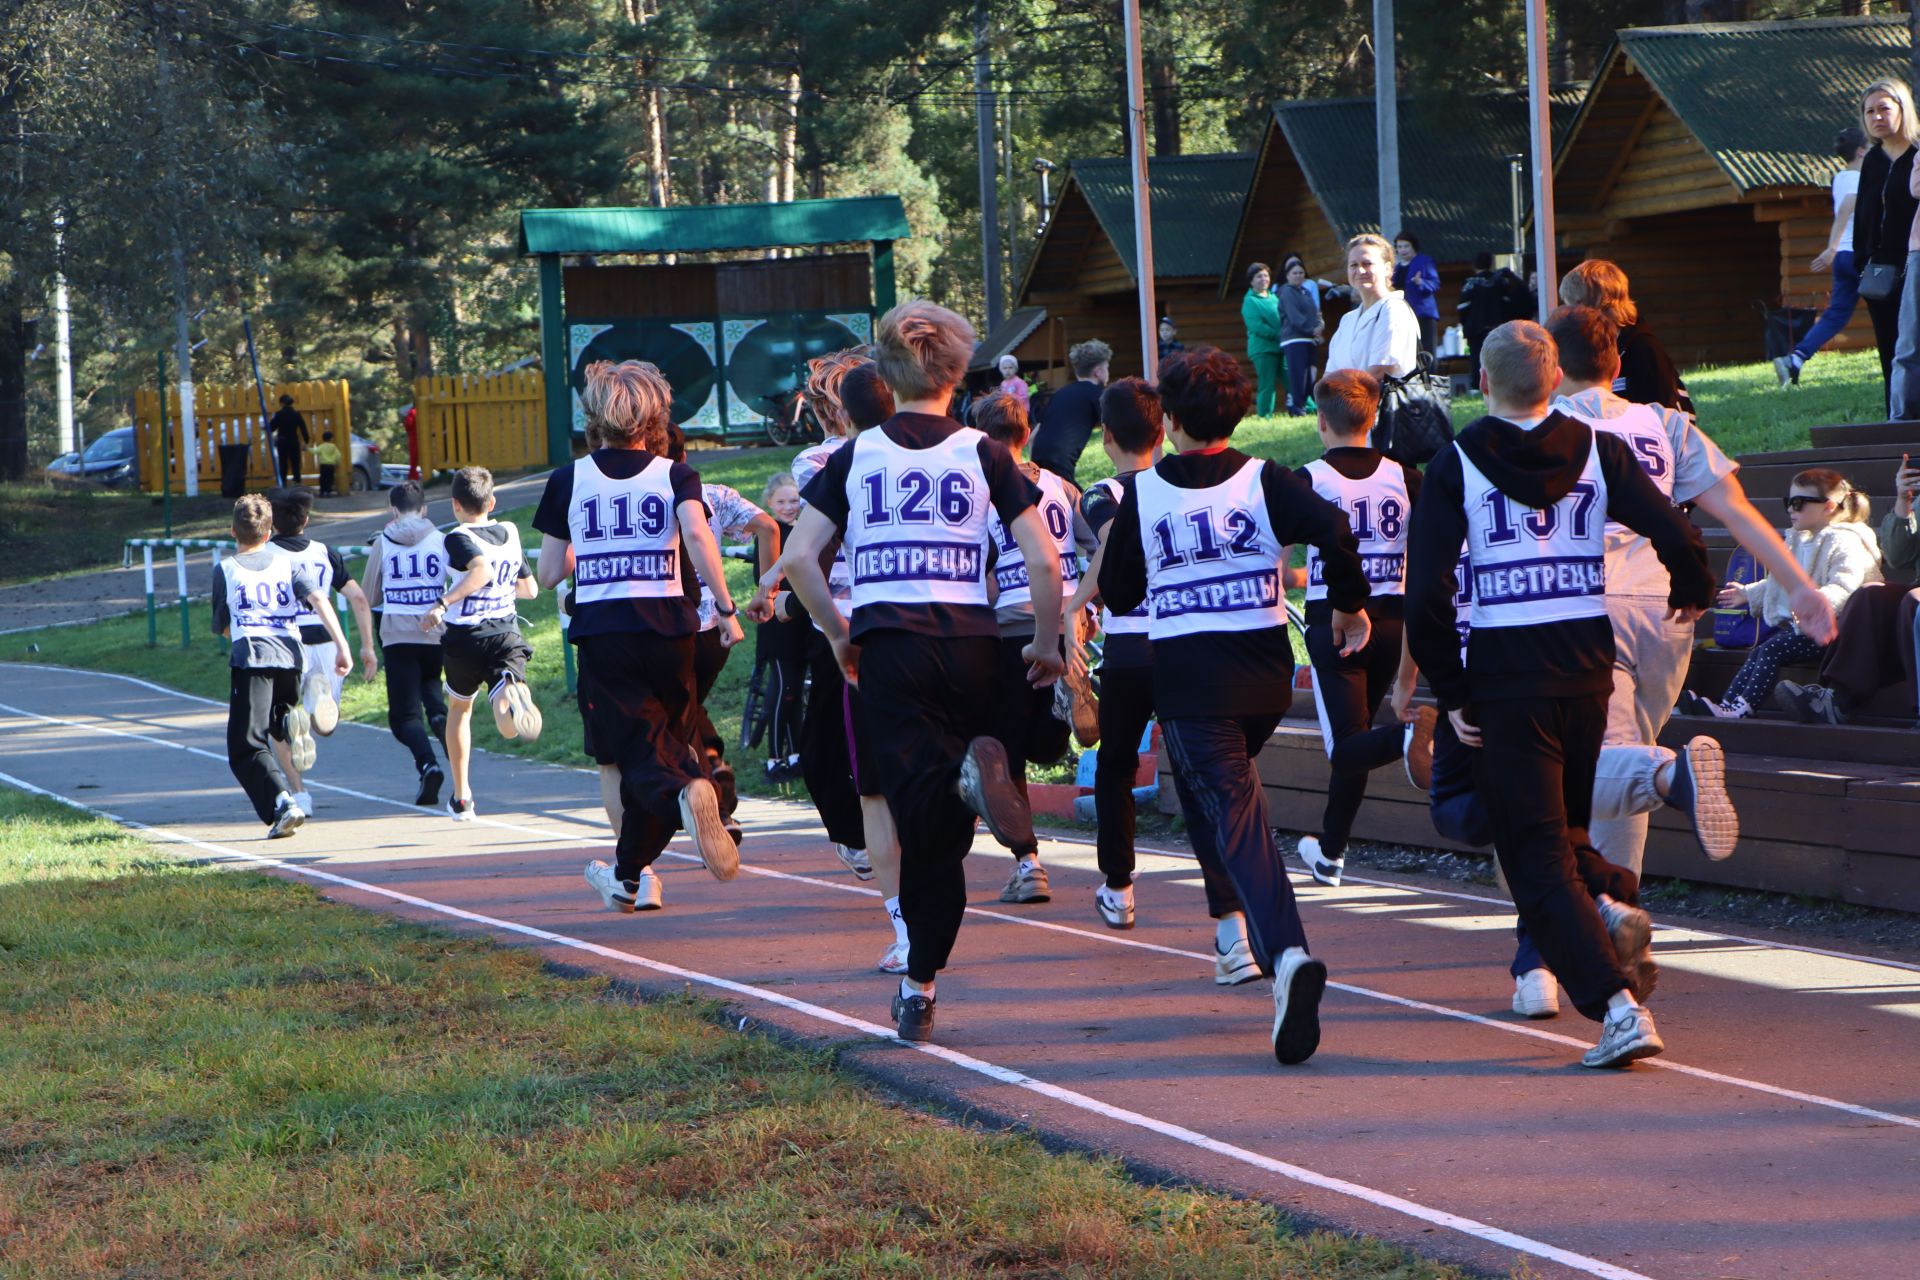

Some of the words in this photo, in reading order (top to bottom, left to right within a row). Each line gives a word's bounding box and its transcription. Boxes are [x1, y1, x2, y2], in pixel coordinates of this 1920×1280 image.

[581, 491, 669, 542] 119
[861, 467, 974, 529] 126
[995, 500, 1069, 556] 10
[1331, 496, 1403, 542] 18
[1153, 506, 1265, 571] 112
[387, 551, 443, 580] 116
[578, 553, 674, 581] ПЕСТРЕЦЫ
[856, 547, 978, 580] ПЕСТРЕЦЫ
[1479, 562, 1605, 598] ПЕСТРЕЦЫ
[235, 581, 291, 609] 108
[1154, 574, 1276, 612] ПЕСТРЕЦЫ
